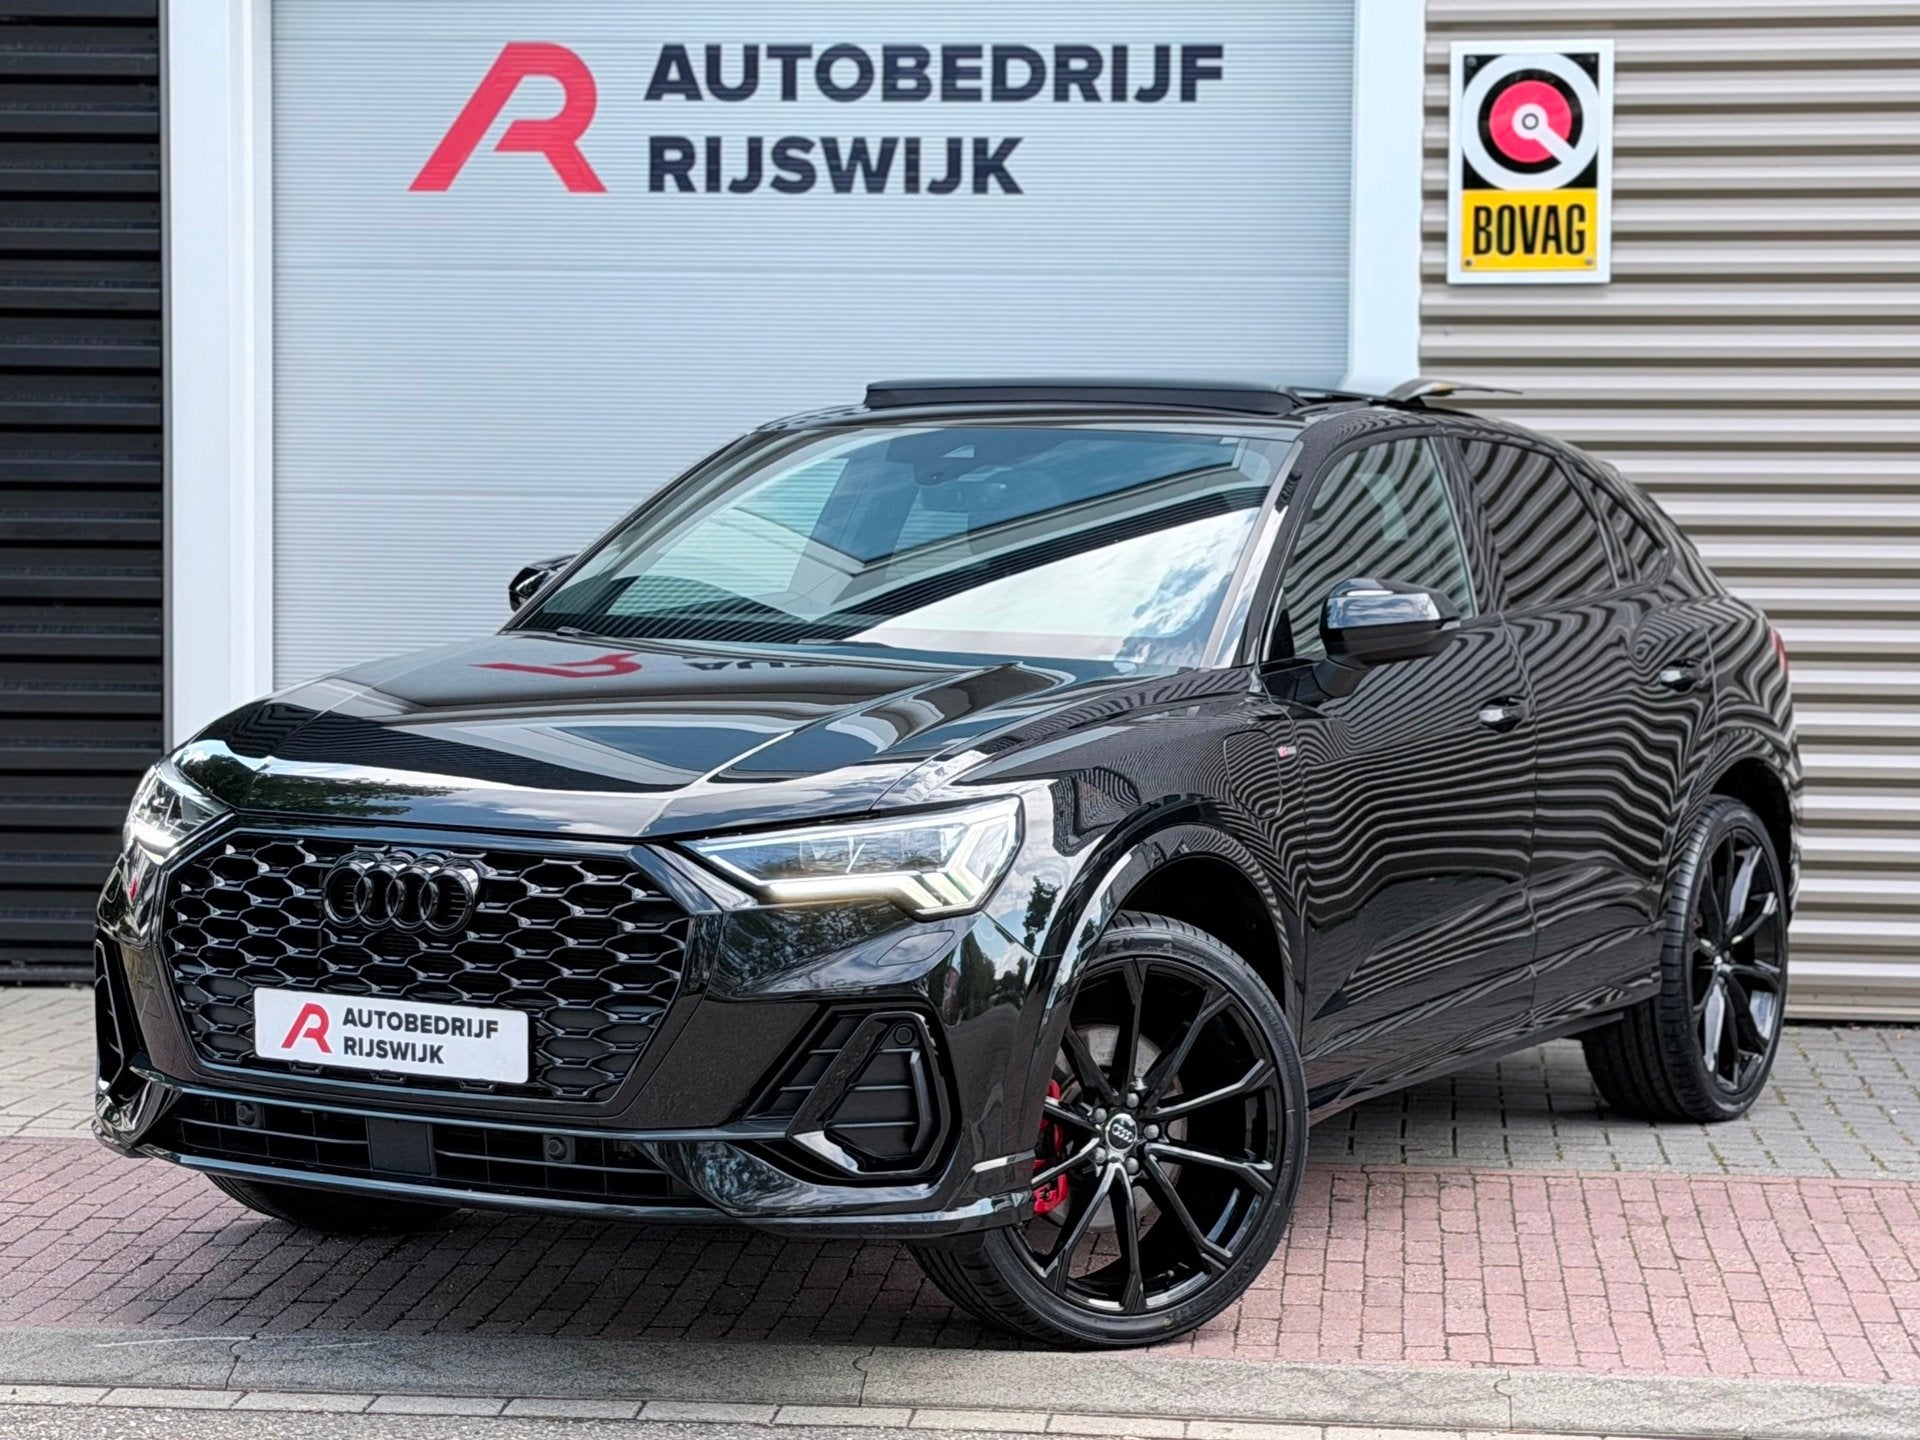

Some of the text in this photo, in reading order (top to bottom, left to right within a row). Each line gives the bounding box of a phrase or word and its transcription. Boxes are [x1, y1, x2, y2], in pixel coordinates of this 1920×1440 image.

[644, 43, 1224, 103] AUTOBEDRIJF
[648, 135, 1023, 195] RIJSWIJK
[1473, 204, 1587, 256] BOVAG
[342, 1006, 499, 1039] AUTOBEDRIJF
[343, 1036, 444, 1064] RIJSWIJK
